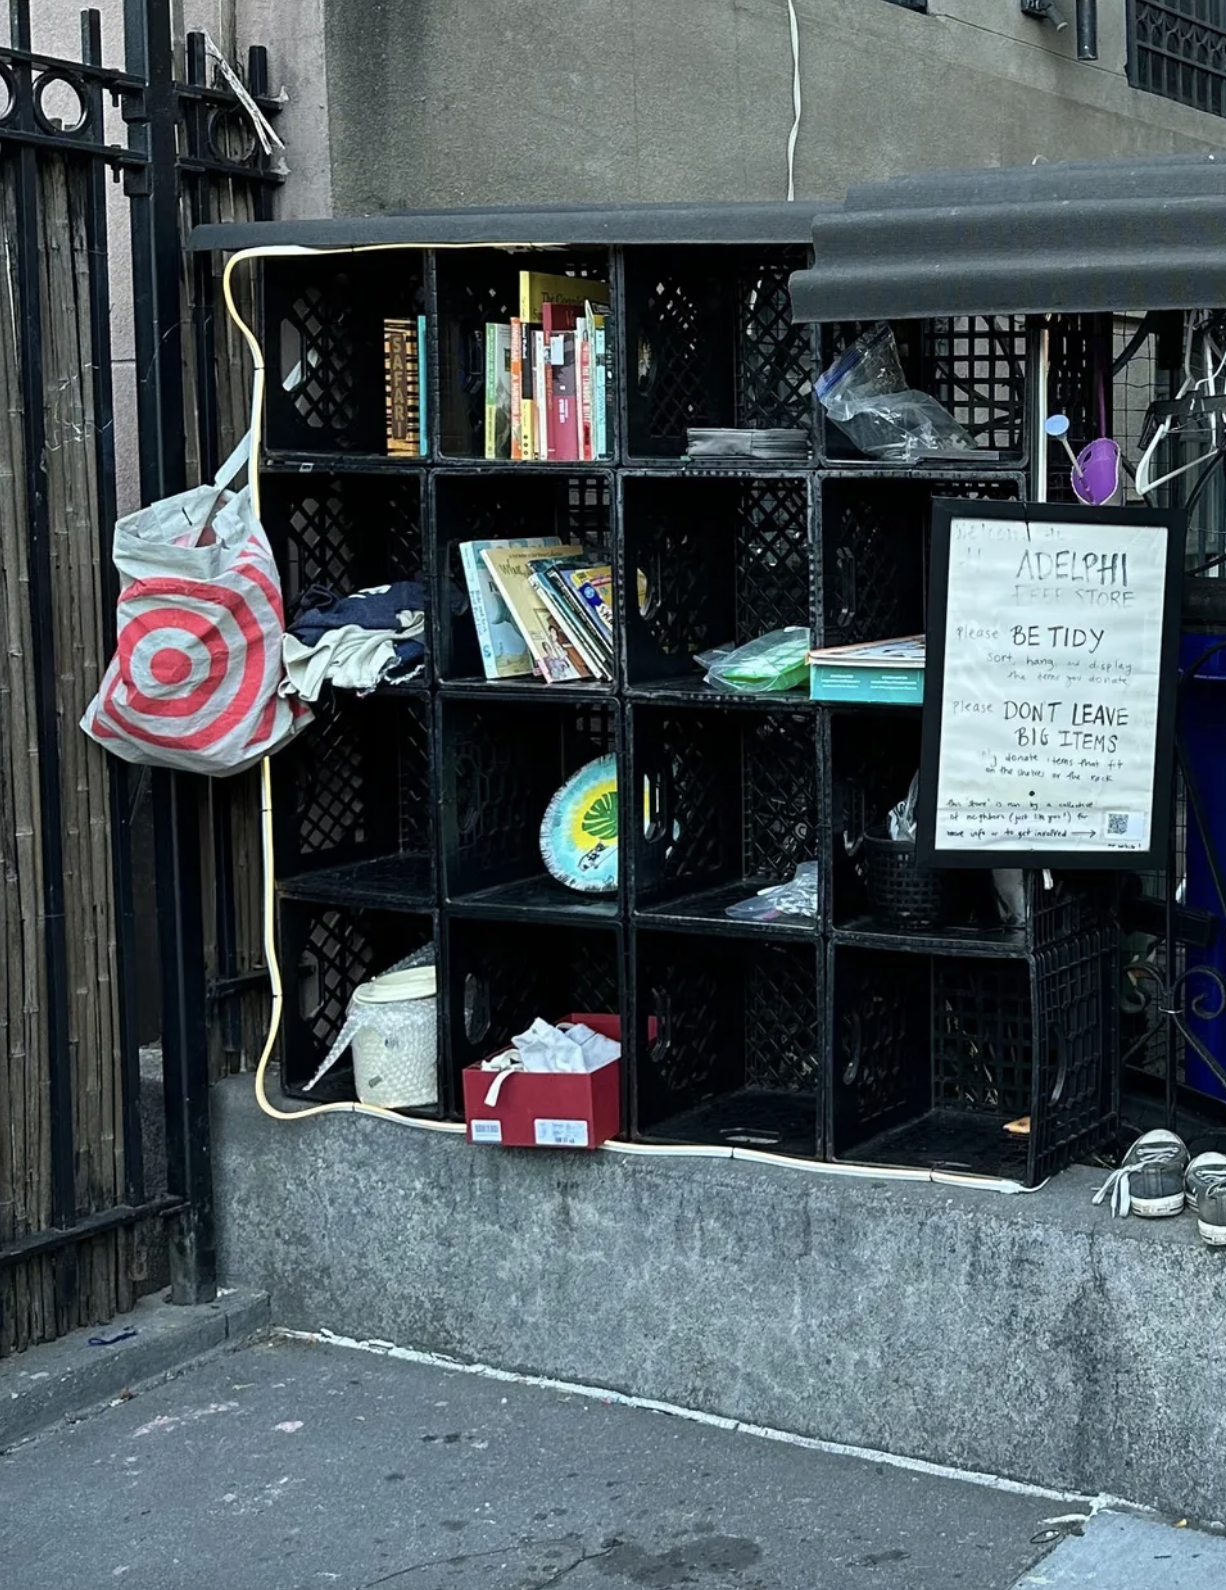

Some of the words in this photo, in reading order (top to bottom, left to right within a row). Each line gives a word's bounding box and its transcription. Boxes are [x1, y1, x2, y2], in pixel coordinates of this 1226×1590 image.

[392, 336, 405, 438] SAFARI
[1016, 549, 1127, 587] ADELPHI
[1075, 588, 1135, 608] STORE
[1010, 625, 1040, 646] BE
[1048, 625, 1105, 654] TIDY
[1089, 660, 1133, 676] display
[1088, 676, 1128, 686] donate
[1071, 702, 1129, 727] LEAVE
[1014, 726, 1049, 747] BIG
[1058, 730, 1119, 753] ITEMS
[1005, 752, 1039, 762] donate
